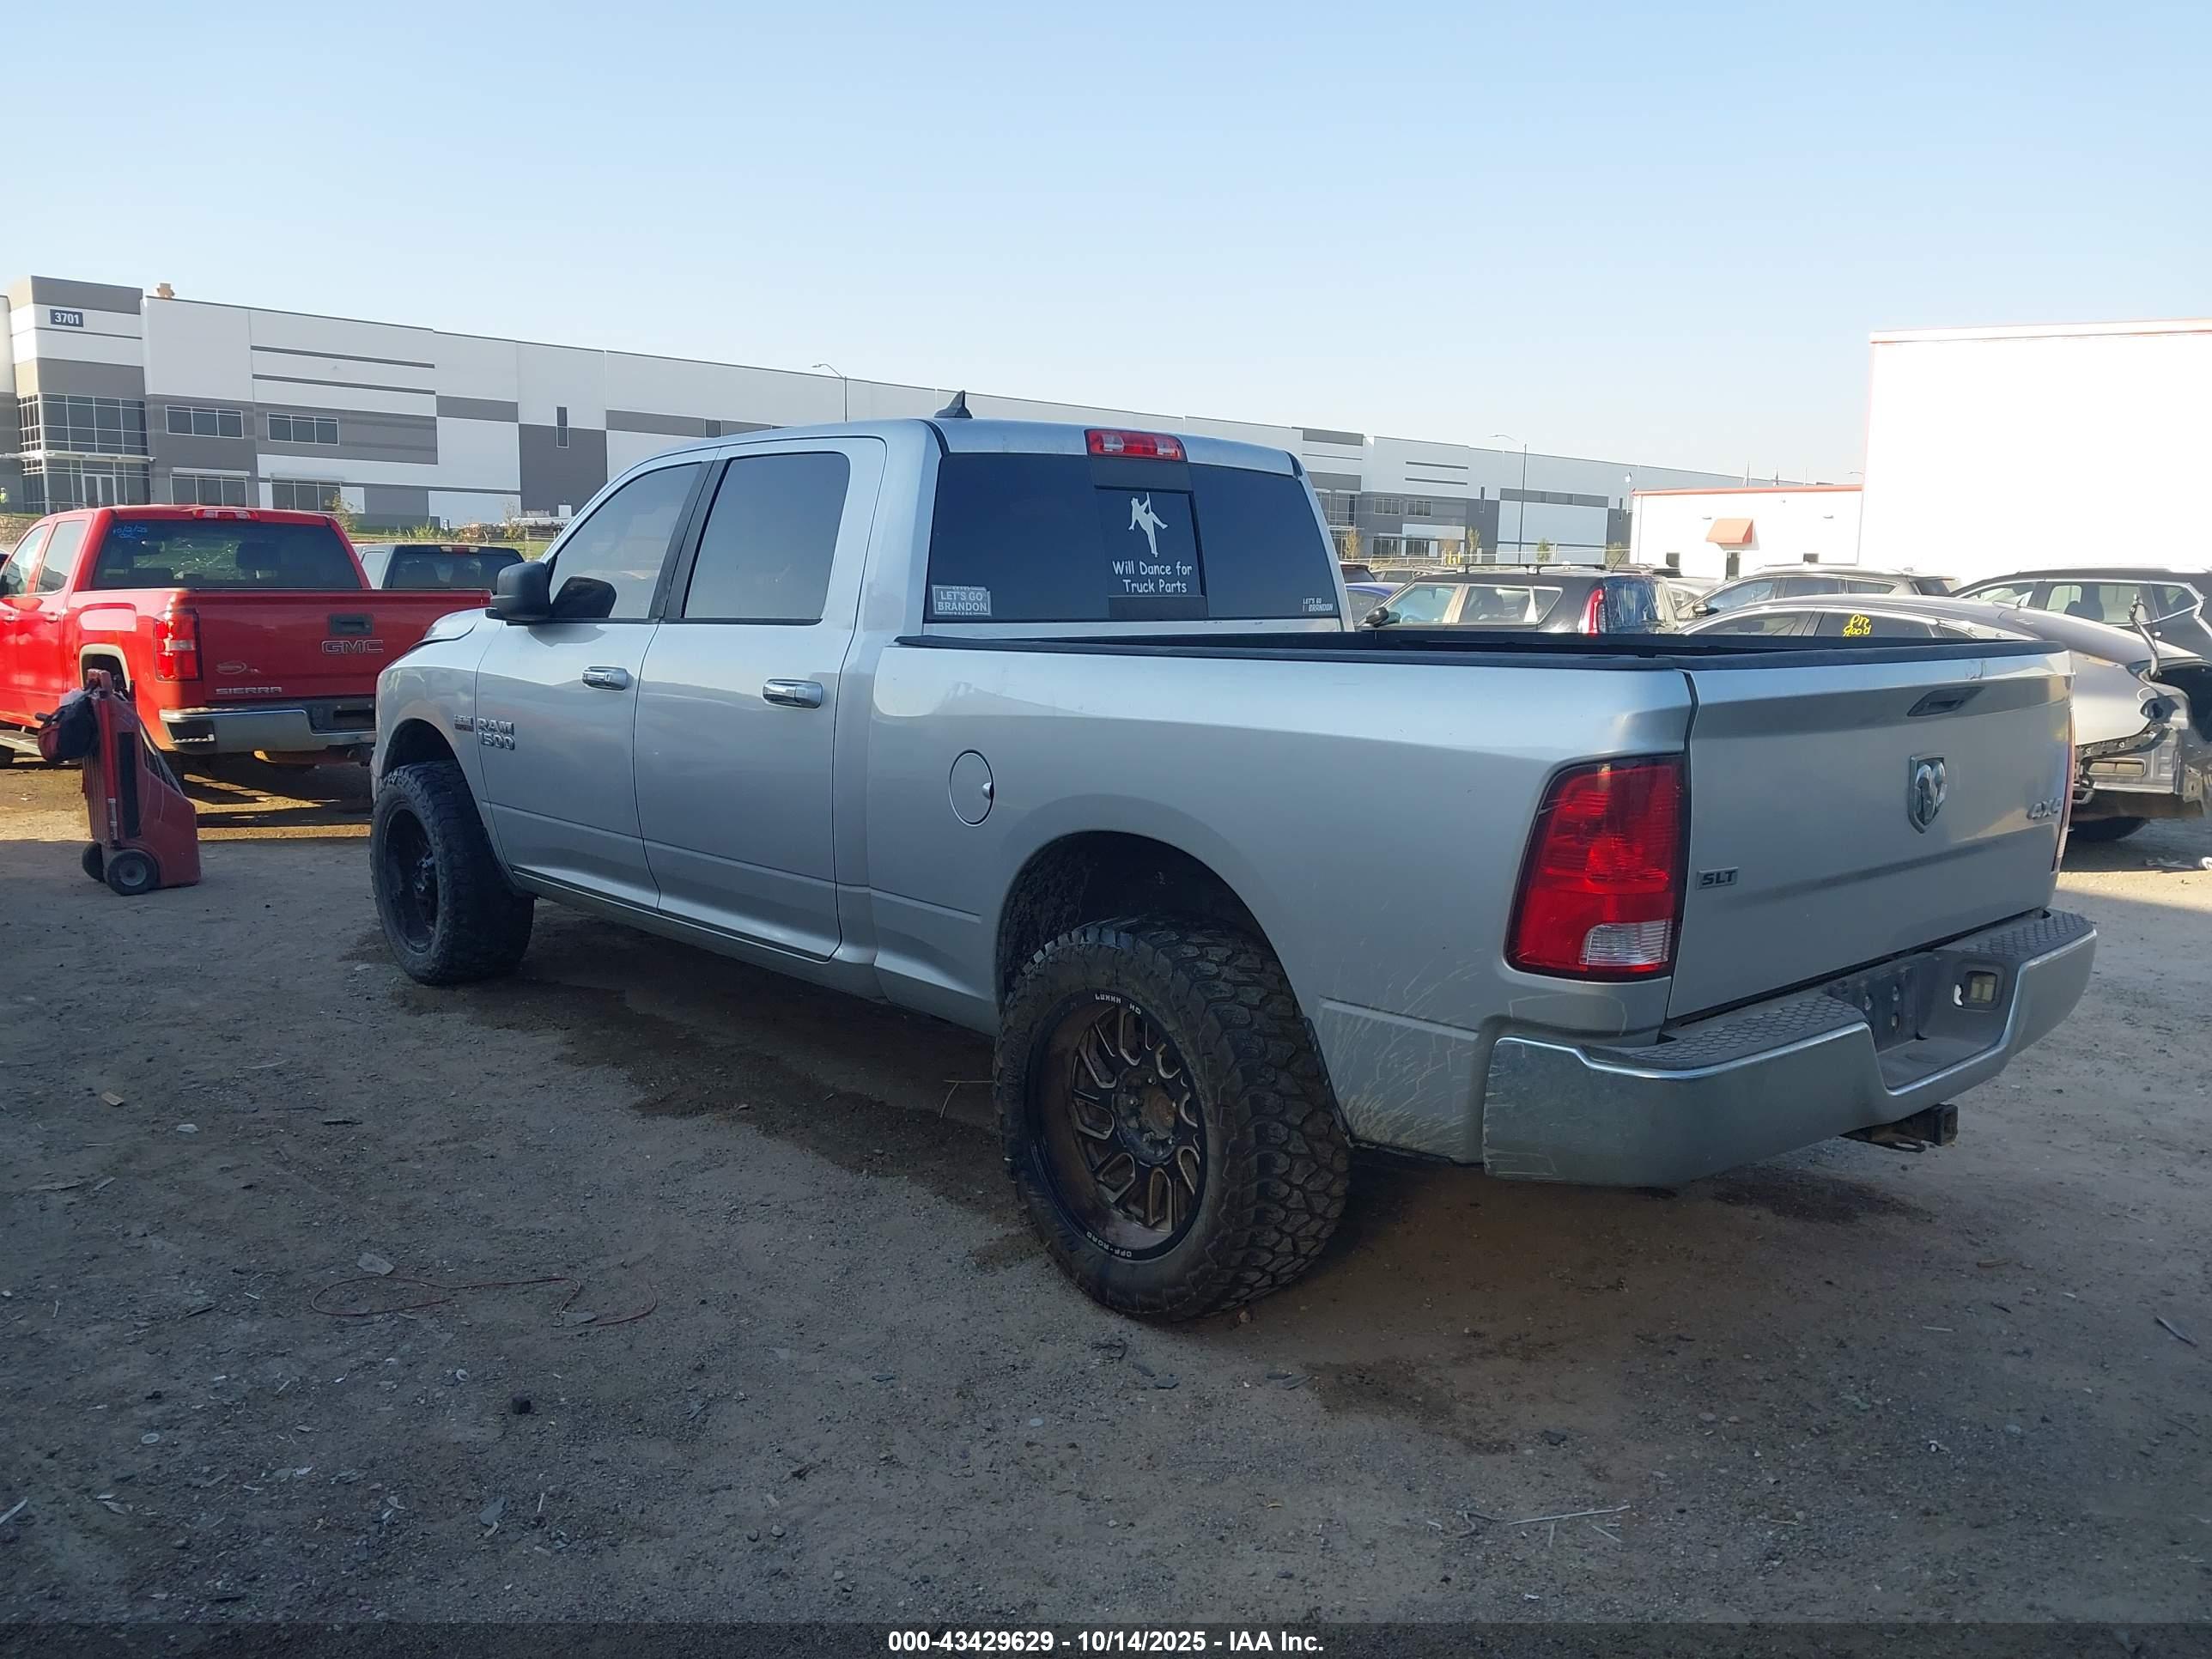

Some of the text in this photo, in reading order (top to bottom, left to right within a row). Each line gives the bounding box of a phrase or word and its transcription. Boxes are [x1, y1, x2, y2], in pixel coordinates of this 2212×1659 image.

[54, 312, 80, 325] 3701
[1112, 560, 1193, 576] Will Dance for
[1122, 578, 1188, 593] Truck Parts
[940, 591, 983, 601] LET'S GO
[937, 602, 988, 611] BRANDON
[1308, 604, 1334, 612] BRANDON
[321, 639, 384, 654] GMC
[215, 686, 283, 695] SIERRA
[477, 717, 514, 734] RAM
[477, 732, 515, 750] 1500
[1701, 871, 1736, 886] SLT
